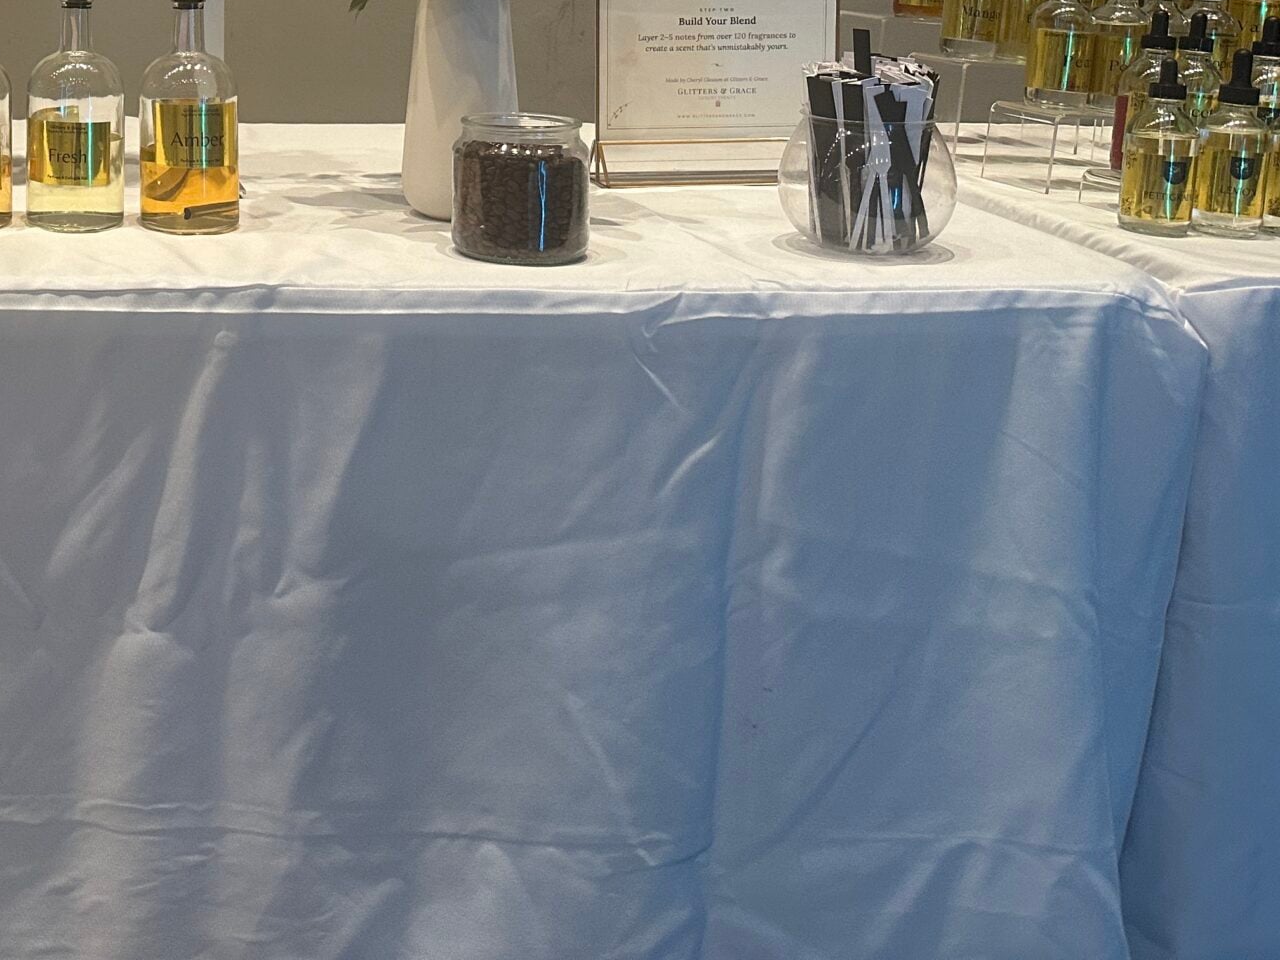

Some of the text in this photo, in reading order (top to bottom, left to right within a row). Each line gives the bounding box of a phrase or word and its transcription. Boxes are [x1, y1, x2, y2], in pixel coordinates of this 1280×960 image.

[679, 16, 756, 25] Build Your Blend
[638, 34, 659, 43] Layer
[696, 33, 715, 42] from
[748, 32, 787, 41] fragrances
[717, 43, 765, 52] unmistakably
[677, 87, 718, 95] GLITTERS
[170, 132, 224, 147] Amber
[49, 148, 87, 164] Fresh
